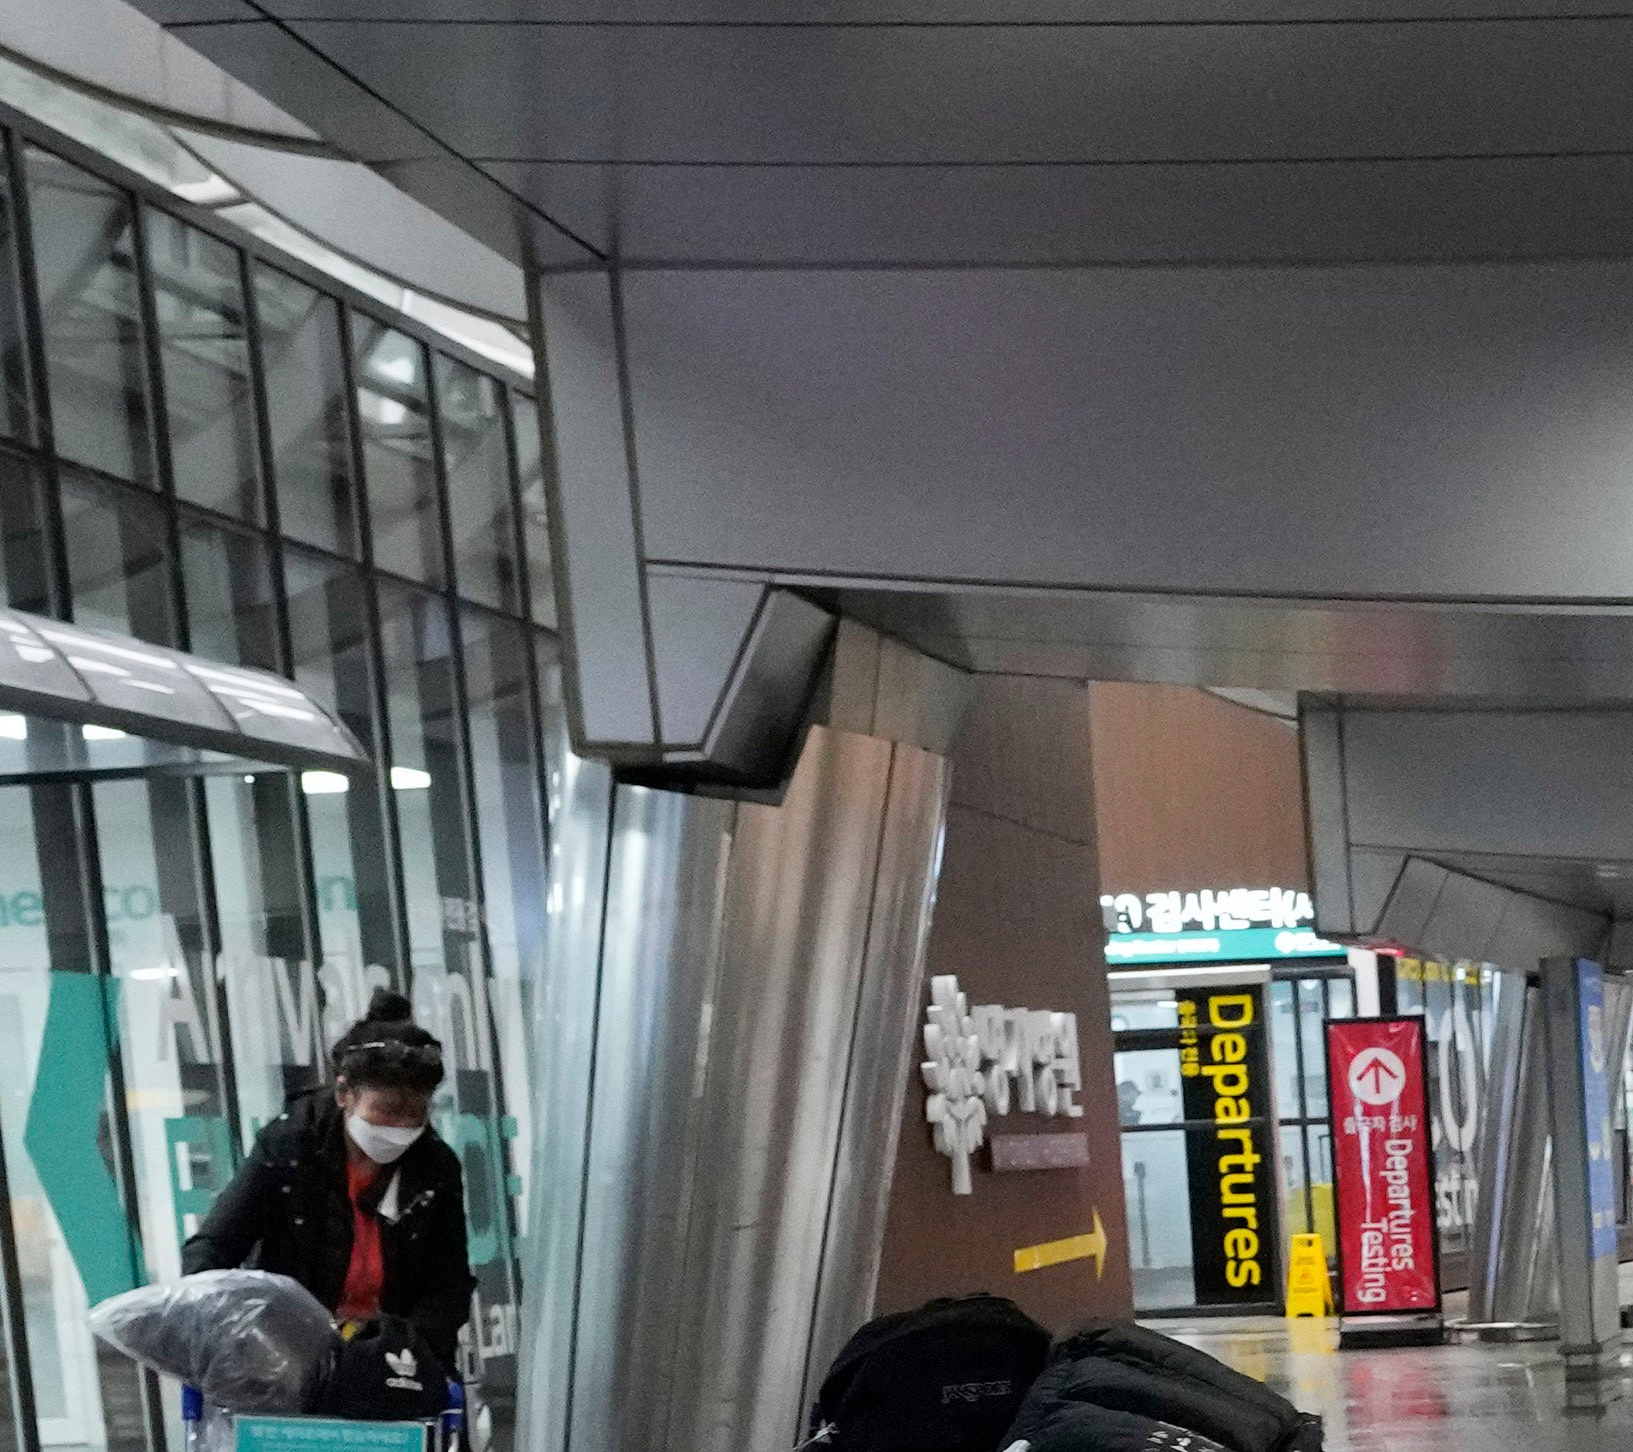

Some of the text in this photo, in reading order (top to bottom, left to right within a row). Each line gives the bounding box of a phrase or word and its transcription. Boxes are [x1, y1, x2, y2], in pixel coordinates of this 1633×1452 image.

[1200, 993, 1262, 1288] Departures
[1378, 1138, 1418, 1273] Departures
[1354, 1217, 1388, 1305] Testing
